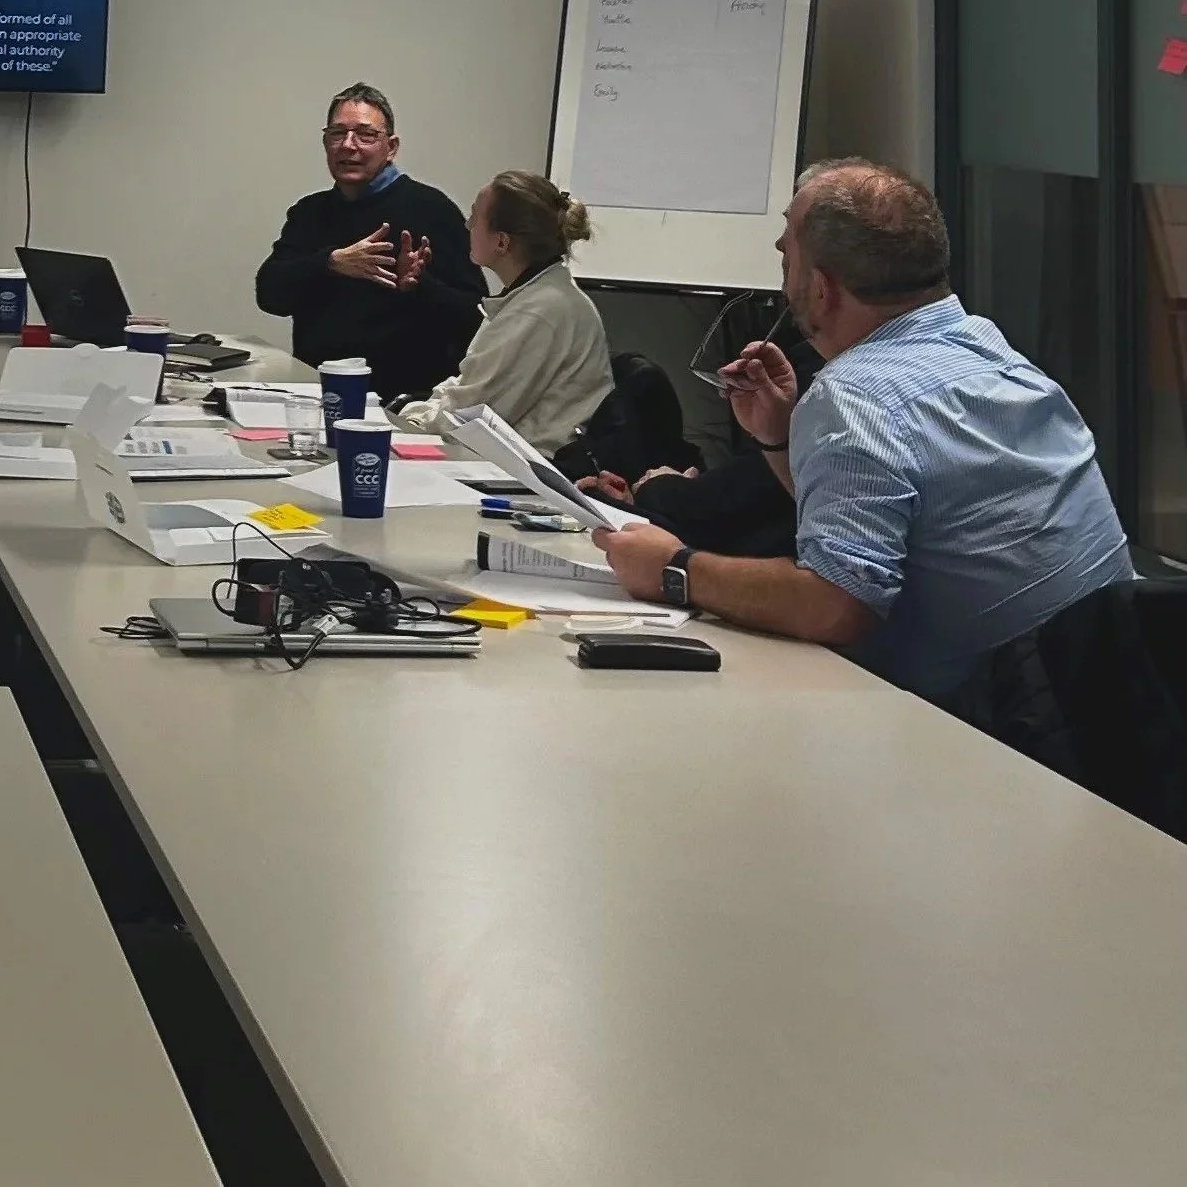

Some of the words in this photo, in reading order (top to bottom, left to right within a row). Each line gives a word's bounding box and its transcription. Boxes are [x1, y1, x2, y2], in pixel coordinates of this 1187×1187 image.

[42, 13, 56, 25] of
[57, 14, 72, 25] all
[9, 30, 82, 43] appropriate
[8, 44, 65, 59] authority
[0, 59, 15, 71] of
[355, 474, 380, 485] CCC
